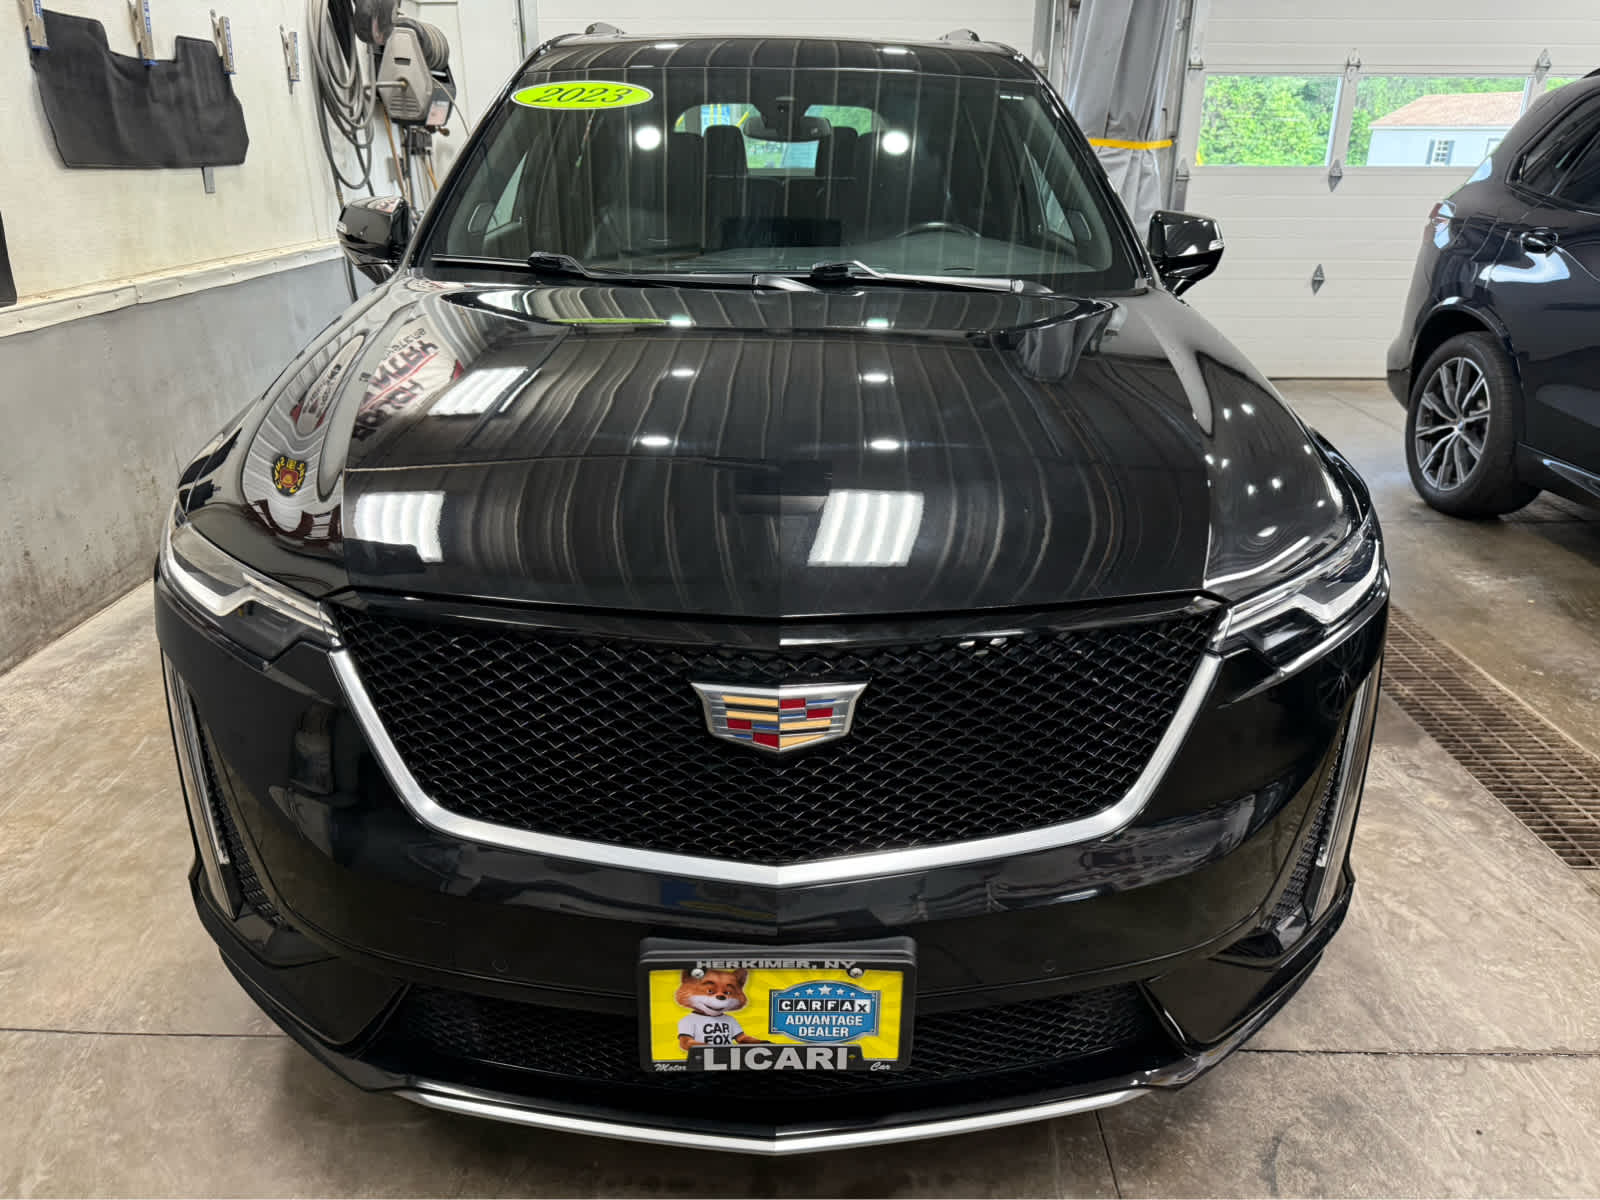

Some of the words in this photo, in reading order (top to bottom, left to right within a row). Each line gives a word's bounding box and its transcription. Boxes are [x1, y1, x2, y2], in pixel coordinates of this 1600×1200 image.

[530, 87, 633, 103] 2023
[824, 959, 857, 969] NY
[778, 999, 871, 1013] CARFAX
[785, 1015, 863, 1026] ADVANTAGE
[703, 1023, 730, 1035] CAR
[798, 1026, 849, 1038] DEALER
[703, 1034, 732, 1045] FOX
[703, 1047, 848, 1071] LICARI
[653, 1062, 688, 1072] Motor
[869, 1061, 892, 1072] Car
